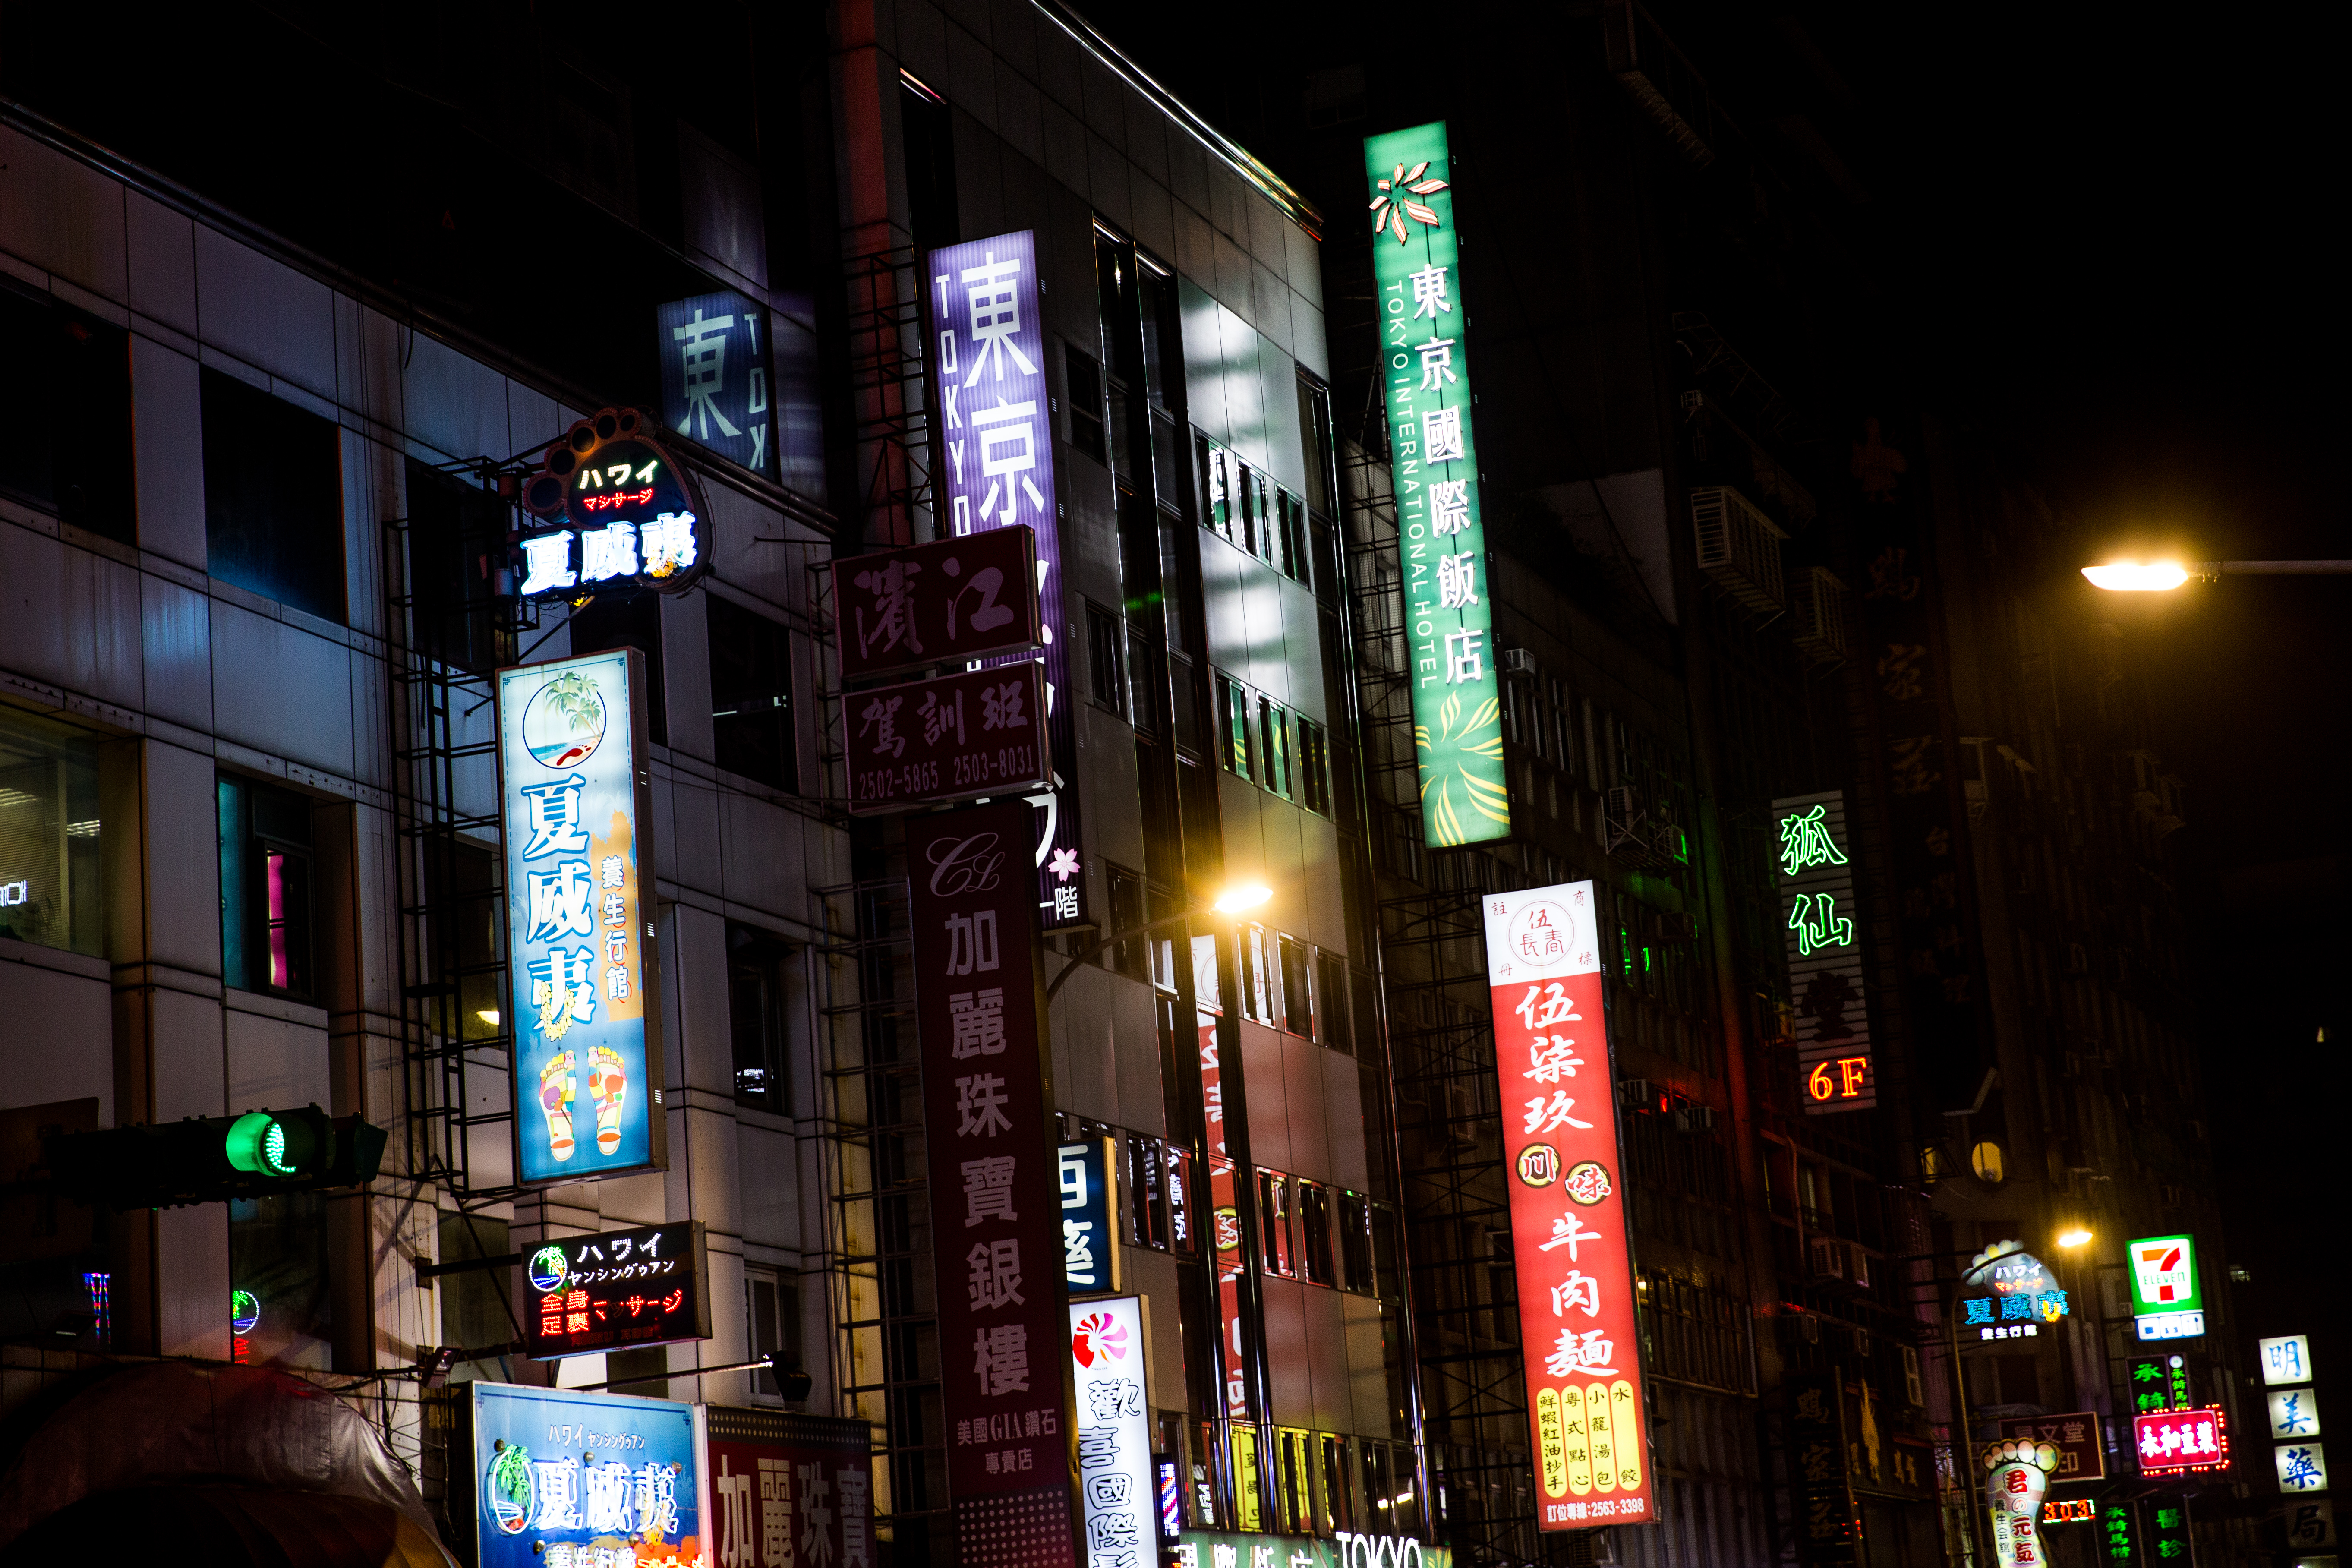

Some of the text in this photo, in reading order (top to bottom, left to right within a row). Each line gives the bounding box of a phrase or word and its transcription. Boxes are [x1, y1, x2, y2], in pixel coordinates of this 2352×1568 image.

[936, 274, 971, 537] TOKYO
[961, 251, 1044, 525] 東京
[579, 459, 658, 490] ハワイ
[1387, 280, 1437, 688] TOKYO INTERNATIONAL HOTEL
[1409, 264, 1484, 684] 東京國際飯店
[520, 511, 697, 595] 夏威夷
[859, 681, 1028, 758] 駕訓班
[859, 744, 1034, 801] 2502-5865 2503-8031
[521, 773, 596, 1032] 夏威夷
[602, 855, 629, 1000] 養生行館
[1039, 886, 1078, 920] 一階
[1810, 1057, 1867, 1100] 6F
[945, 909, 1030, 1397] 加麗珠寶銀樓
[1515, 983, 1619, 1377] 伍柒玖 川味 牛肉麵
[577, 1233, 661, 1263] ハワイ
[1995, 1263, 2042, 1279] ハワイ
[1963, 1290, 2070, 1325] 夏威夷
[548, 1423, 583, 1448] ハワイ
[985, 1448, 1032, 1474] 專賣店
[1540, 1394, 1563, 1490] 鮮蝦紅油抄手
[1589, 1391, 1613, 1485] 小籠湯包
[1613, 1388, 1638, 1483] 水餃
[2269, 1341, 2326, 1543] 明美藥局
[532, 1456, 679, 1536] 夏威夷
